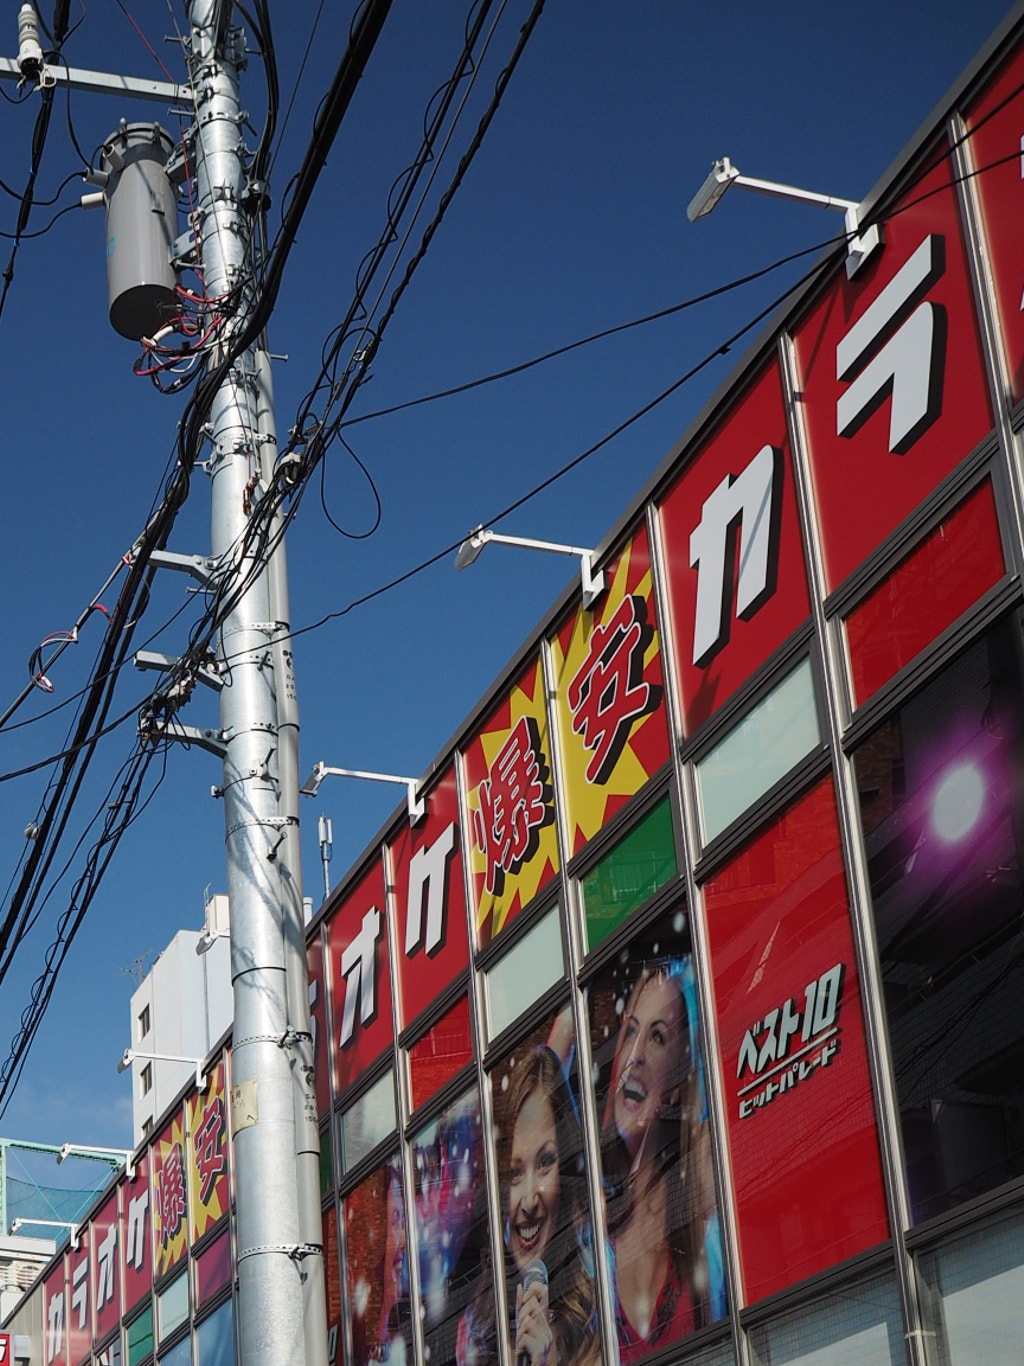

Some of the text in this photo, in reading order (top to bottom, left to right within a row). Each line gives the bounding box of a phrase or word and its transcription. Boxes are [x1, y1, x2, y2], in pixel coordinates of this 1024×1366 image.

[689, 233, 1024, 670] カラ
[474, 593, 664, 897] 爆安
[309, 821, 459, 1048] オケ
[48, 1189, 150, 1365] カラオケ
[158, 1095, 227, 1249] 爆安
